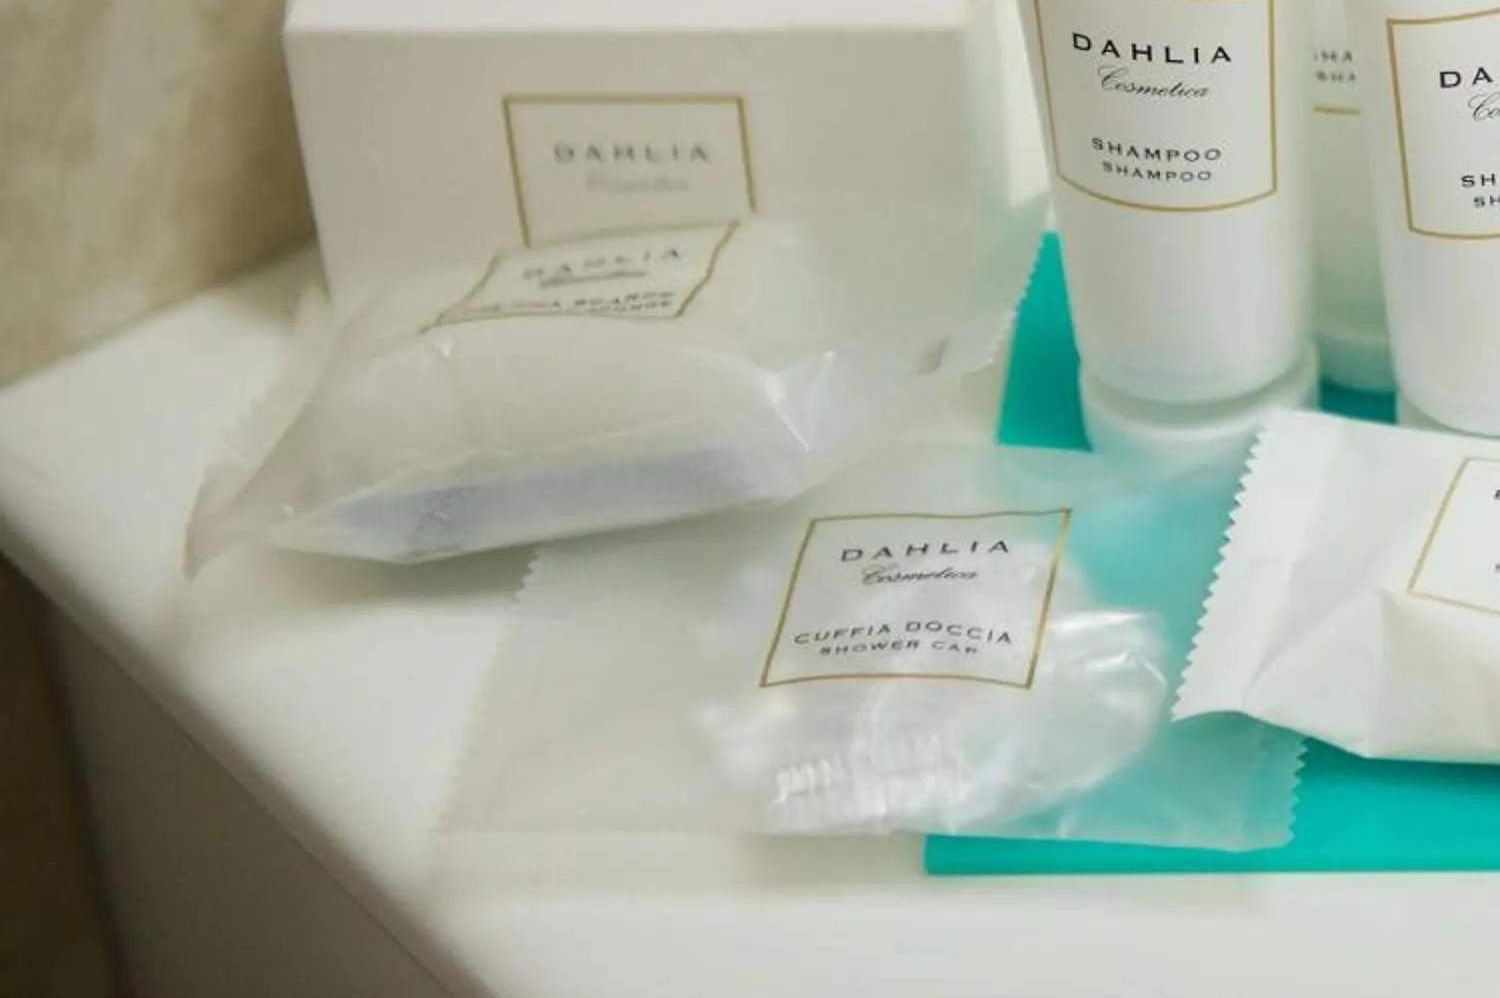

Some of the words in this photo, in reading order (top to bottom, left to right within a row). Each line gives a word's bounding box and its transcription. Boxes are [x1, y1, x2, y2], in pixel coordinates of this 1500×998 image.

[1072, 32, 1231, 65] DAHLIA
[1097, 64, 1210, 99] Cosmetica
[553, 141, 710, 164] DAHLIA
[1091, 137, 1221, 162] SHAMPOO
[1102, 161, 1212, 182] SHAMPOO
[840, 540, 1010, 562] DAHLIA
[794, 624, 891, 644] CUFFIA
[905, 620, 1012, 645] DOCCIA
[820, 639, 919, 656] SHOWER
[931, 640, 977, 655] CAP
